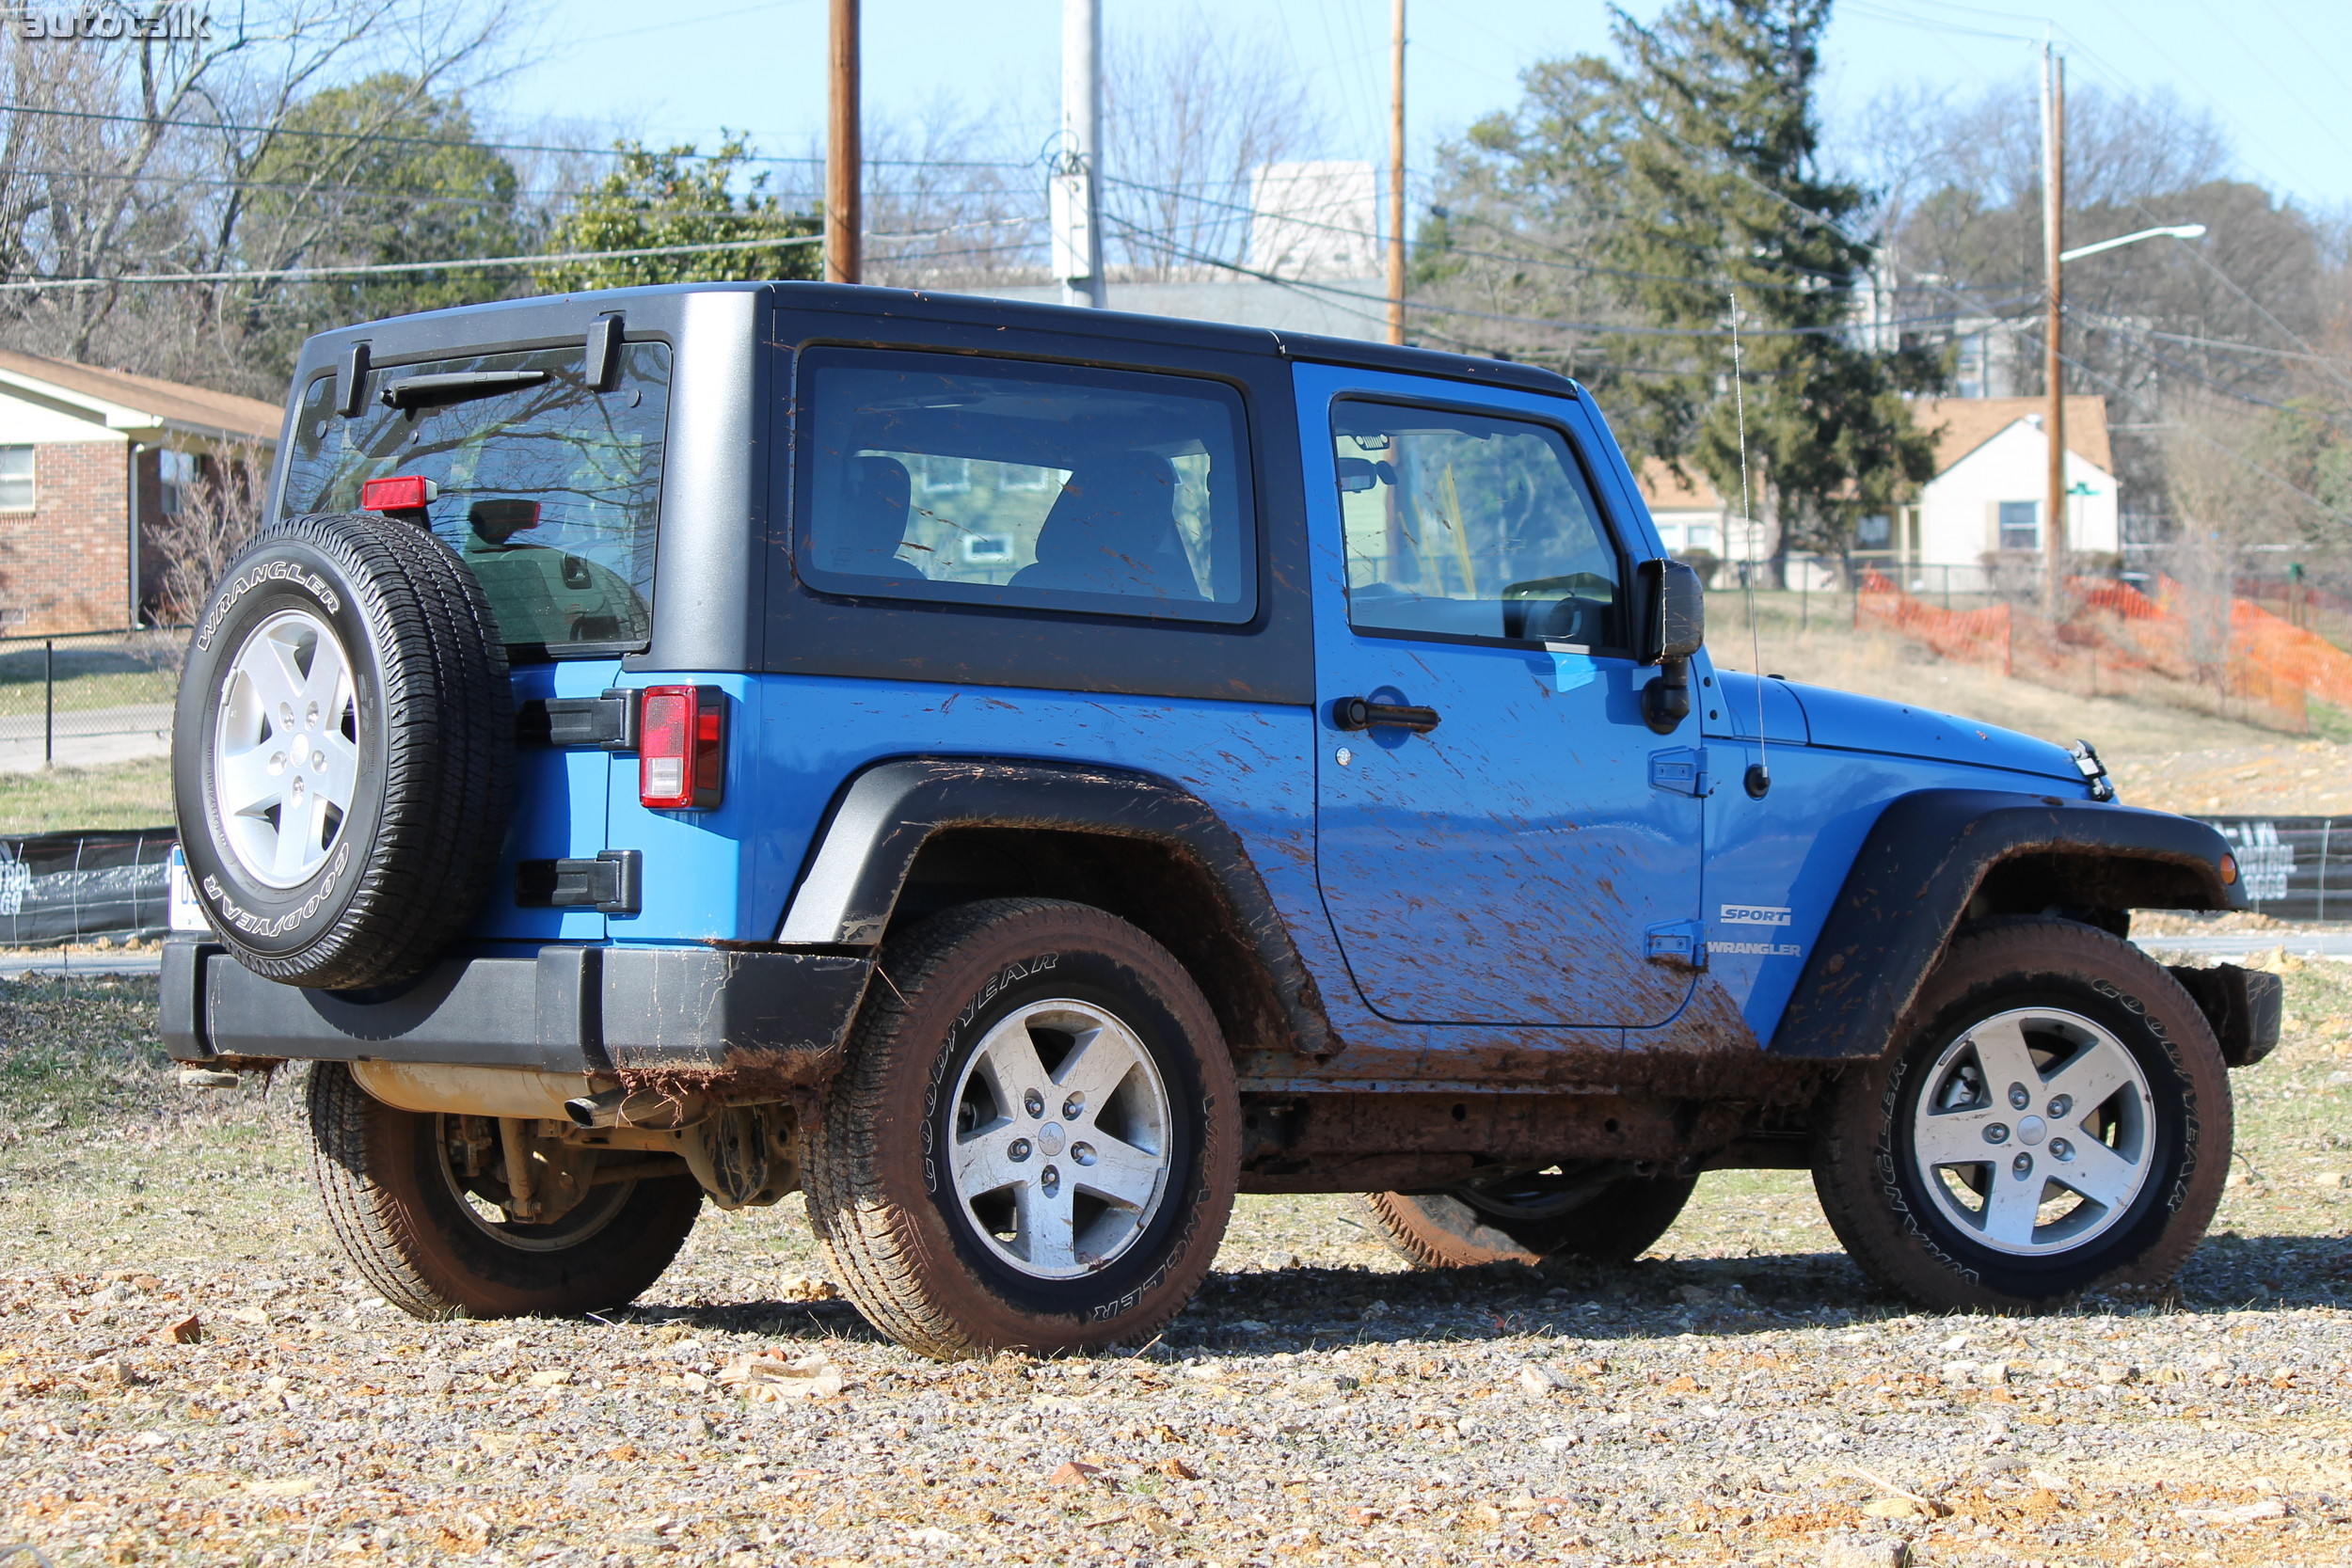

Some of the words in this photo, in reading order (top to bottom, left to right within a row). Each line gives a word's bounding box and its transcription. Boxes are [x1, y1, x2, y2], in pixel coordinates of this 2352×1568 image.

[198, 561, 340, 651] WRANGLER
[203, 842, 349, 939] GOODYEAR
[1724, 909, 1791, 922] SPORT
[1707, 942, 1802, 958] WRANGLER
[919, 951, 1059, 1193] GOODYEAR
[2090, 978, 2201, 1213] GOODYEAR
[1877, 1056, 1979, 1287] WRANGLER
